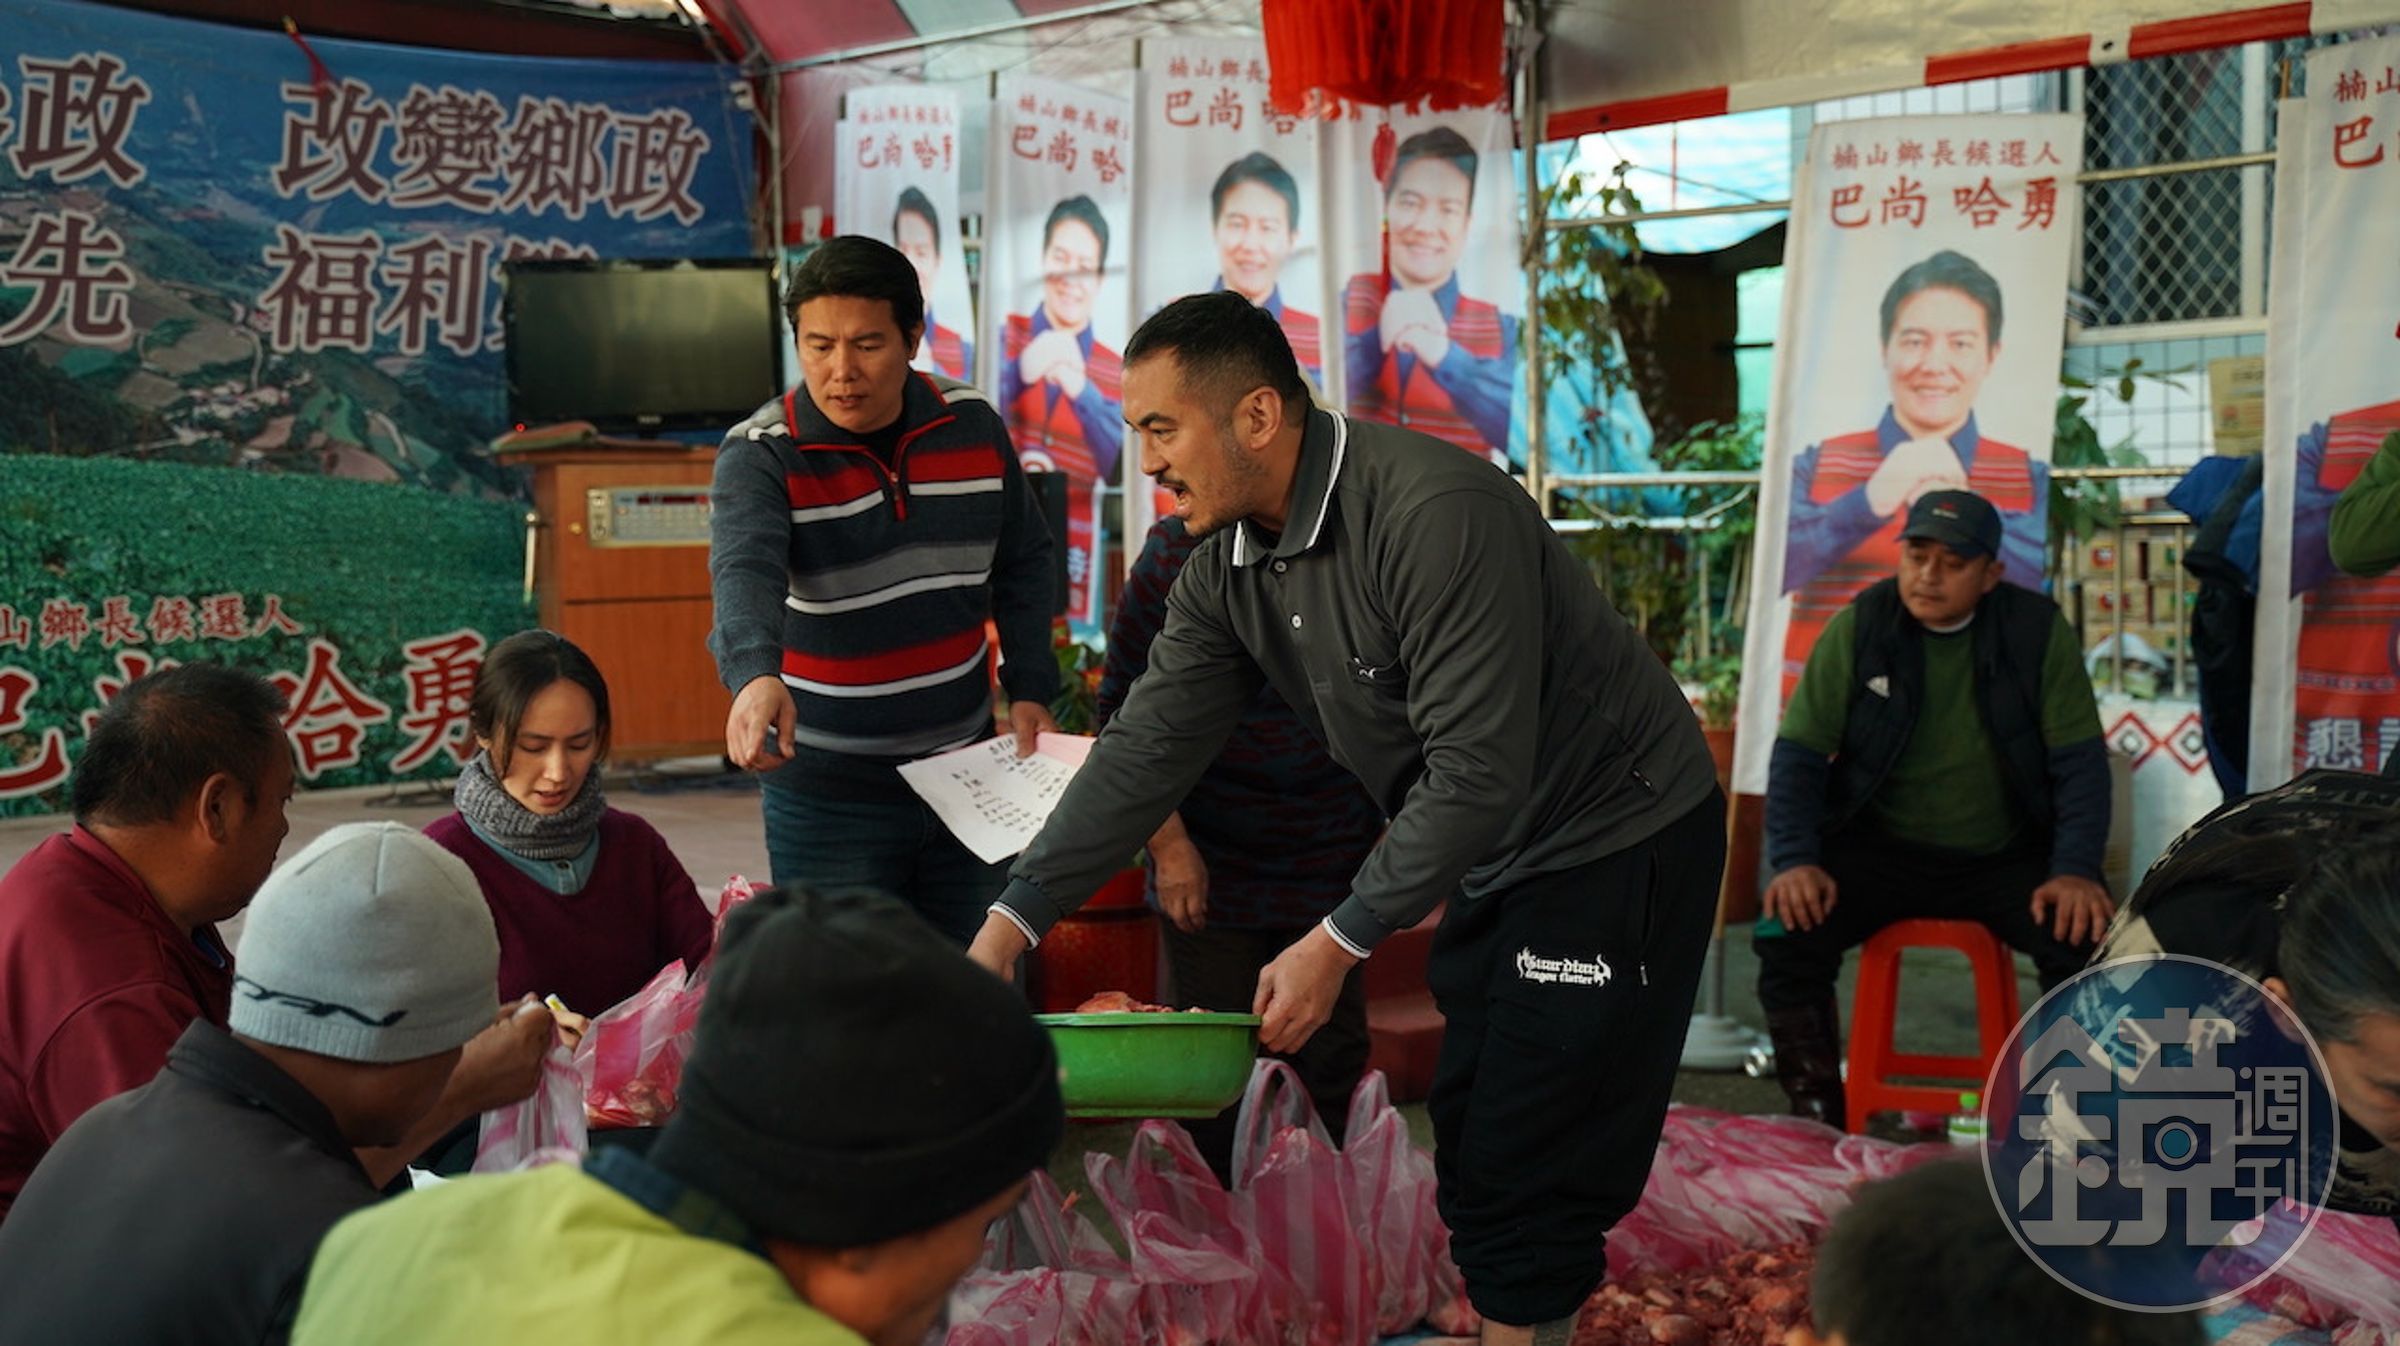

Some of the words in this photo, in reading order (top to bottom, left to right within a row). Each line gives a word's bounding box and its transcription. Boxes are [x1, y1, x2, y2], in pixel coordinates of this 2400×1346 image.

[1164, 87, 1244, 131] 巴尚
[0, 52, 151, 188] 政
[271, 77, 711, 226] 改變鄉政
[1012, 124, 1078, 173] 巴尚
[2333, 115, 2384, 170] 巴
[1829, 175, 1928, 230] 巴尚
[1952, 175, 2060, 231] 哈勇
[0, 209, 136, 347] 先
[262, 223, 600, 354] 福利
